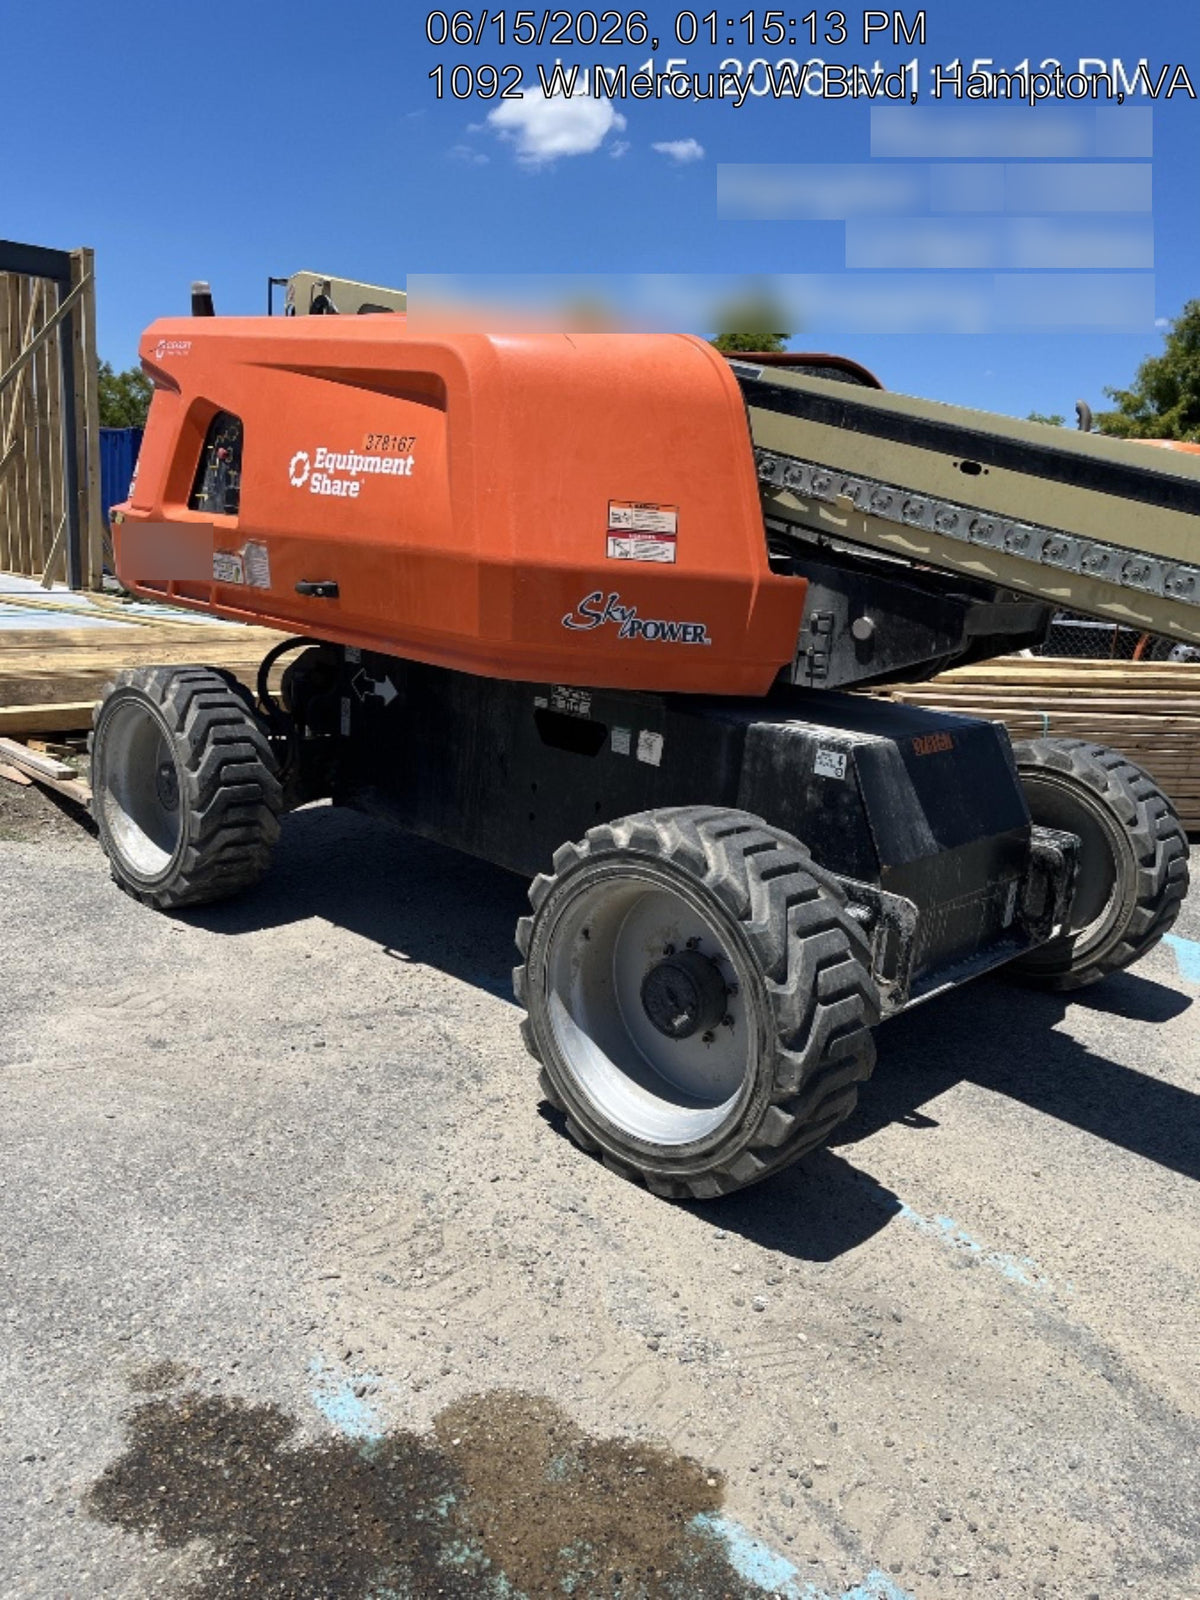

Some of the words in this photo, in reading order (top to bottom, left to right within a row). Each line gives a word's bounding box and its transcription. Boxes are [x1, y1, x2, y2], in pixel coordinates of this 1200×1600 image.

[365, 434, 416, 452] 378167
[314, 447, 415, 476] Equipment
[310, 472, 360, 497] Share
[561, 590, 637, 638] Sky
[626, 618, 708, 644] POWER
